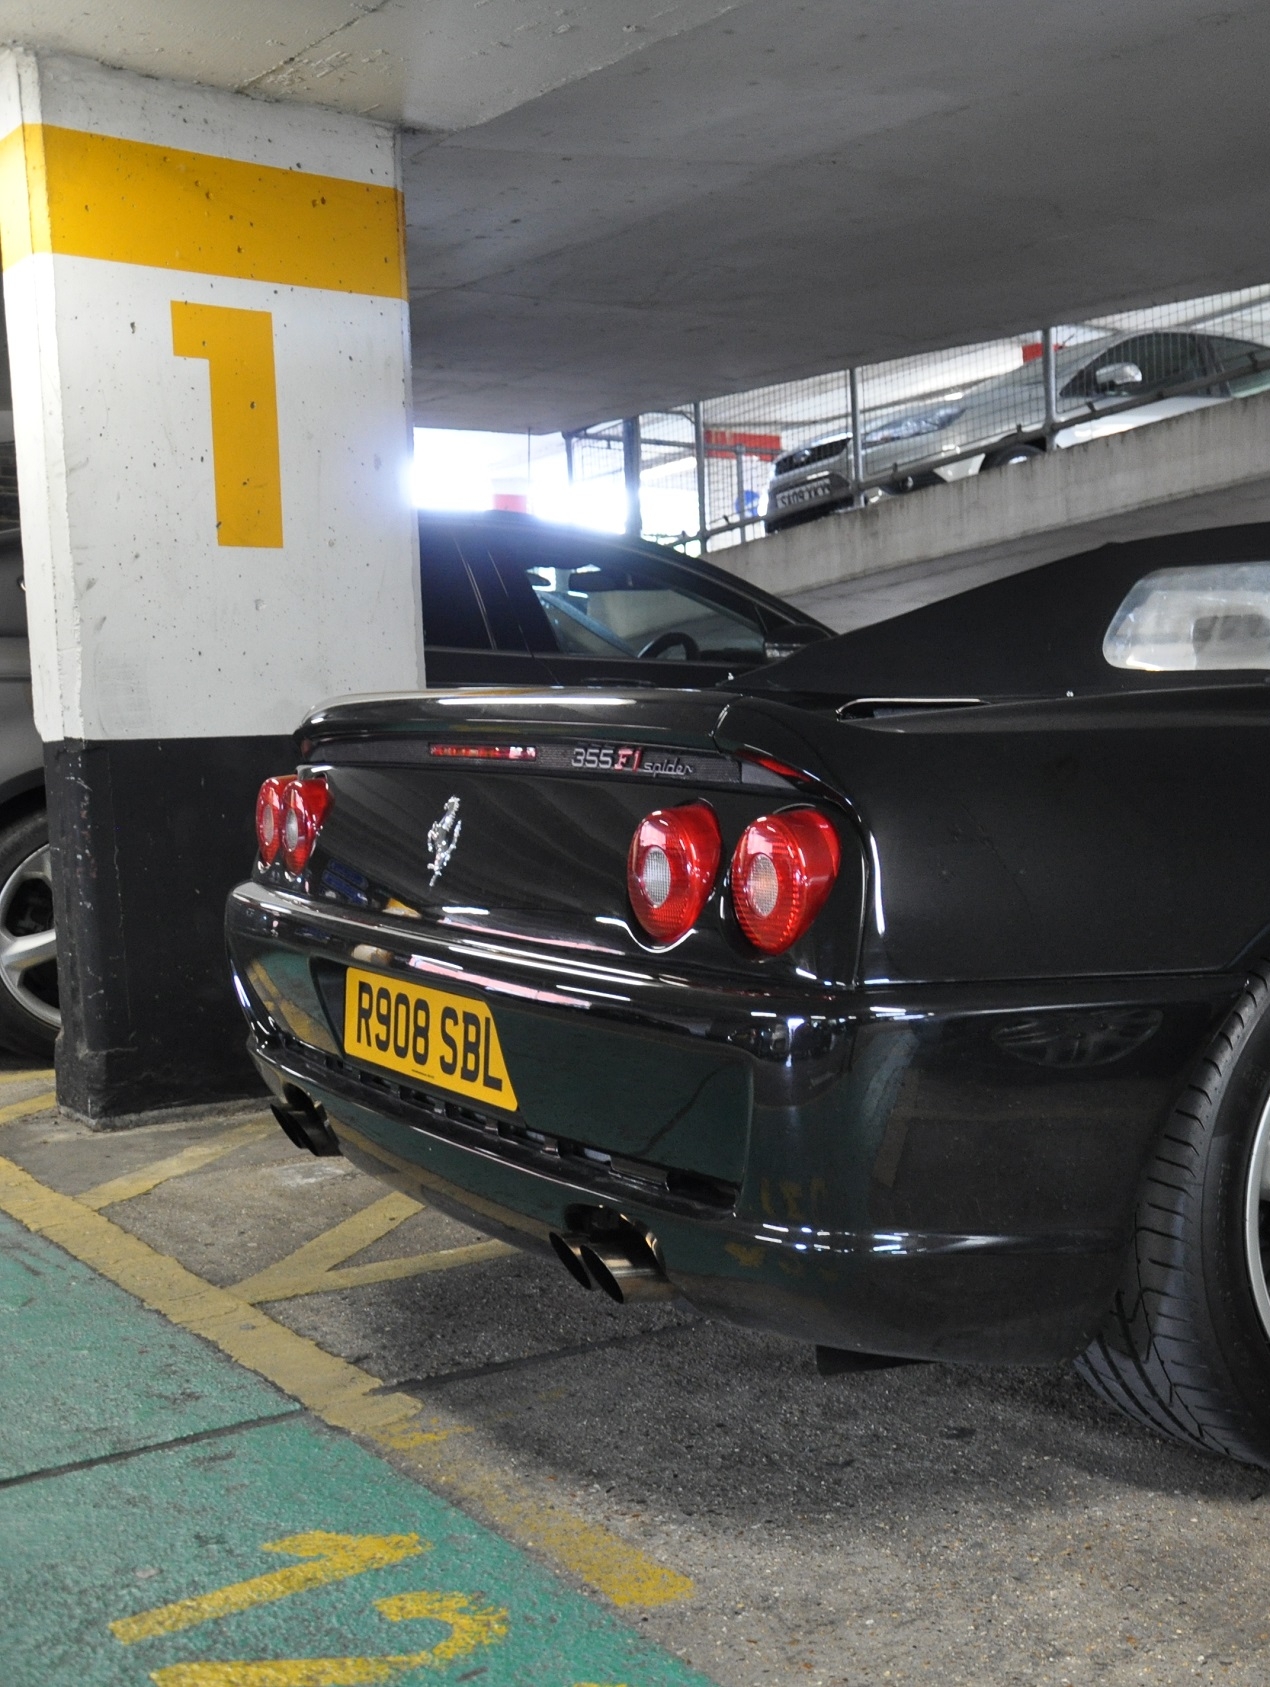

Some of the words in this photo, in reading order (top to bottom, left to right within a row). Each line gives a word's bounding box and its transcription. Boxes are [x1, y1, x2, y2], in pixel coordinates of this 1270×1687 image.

[170, 300, 284, 548] 1
[643, 759, 693, 778] spider
[357, 980, 430, 1066] R908
[439, 1006, 503, 1092] SBL
